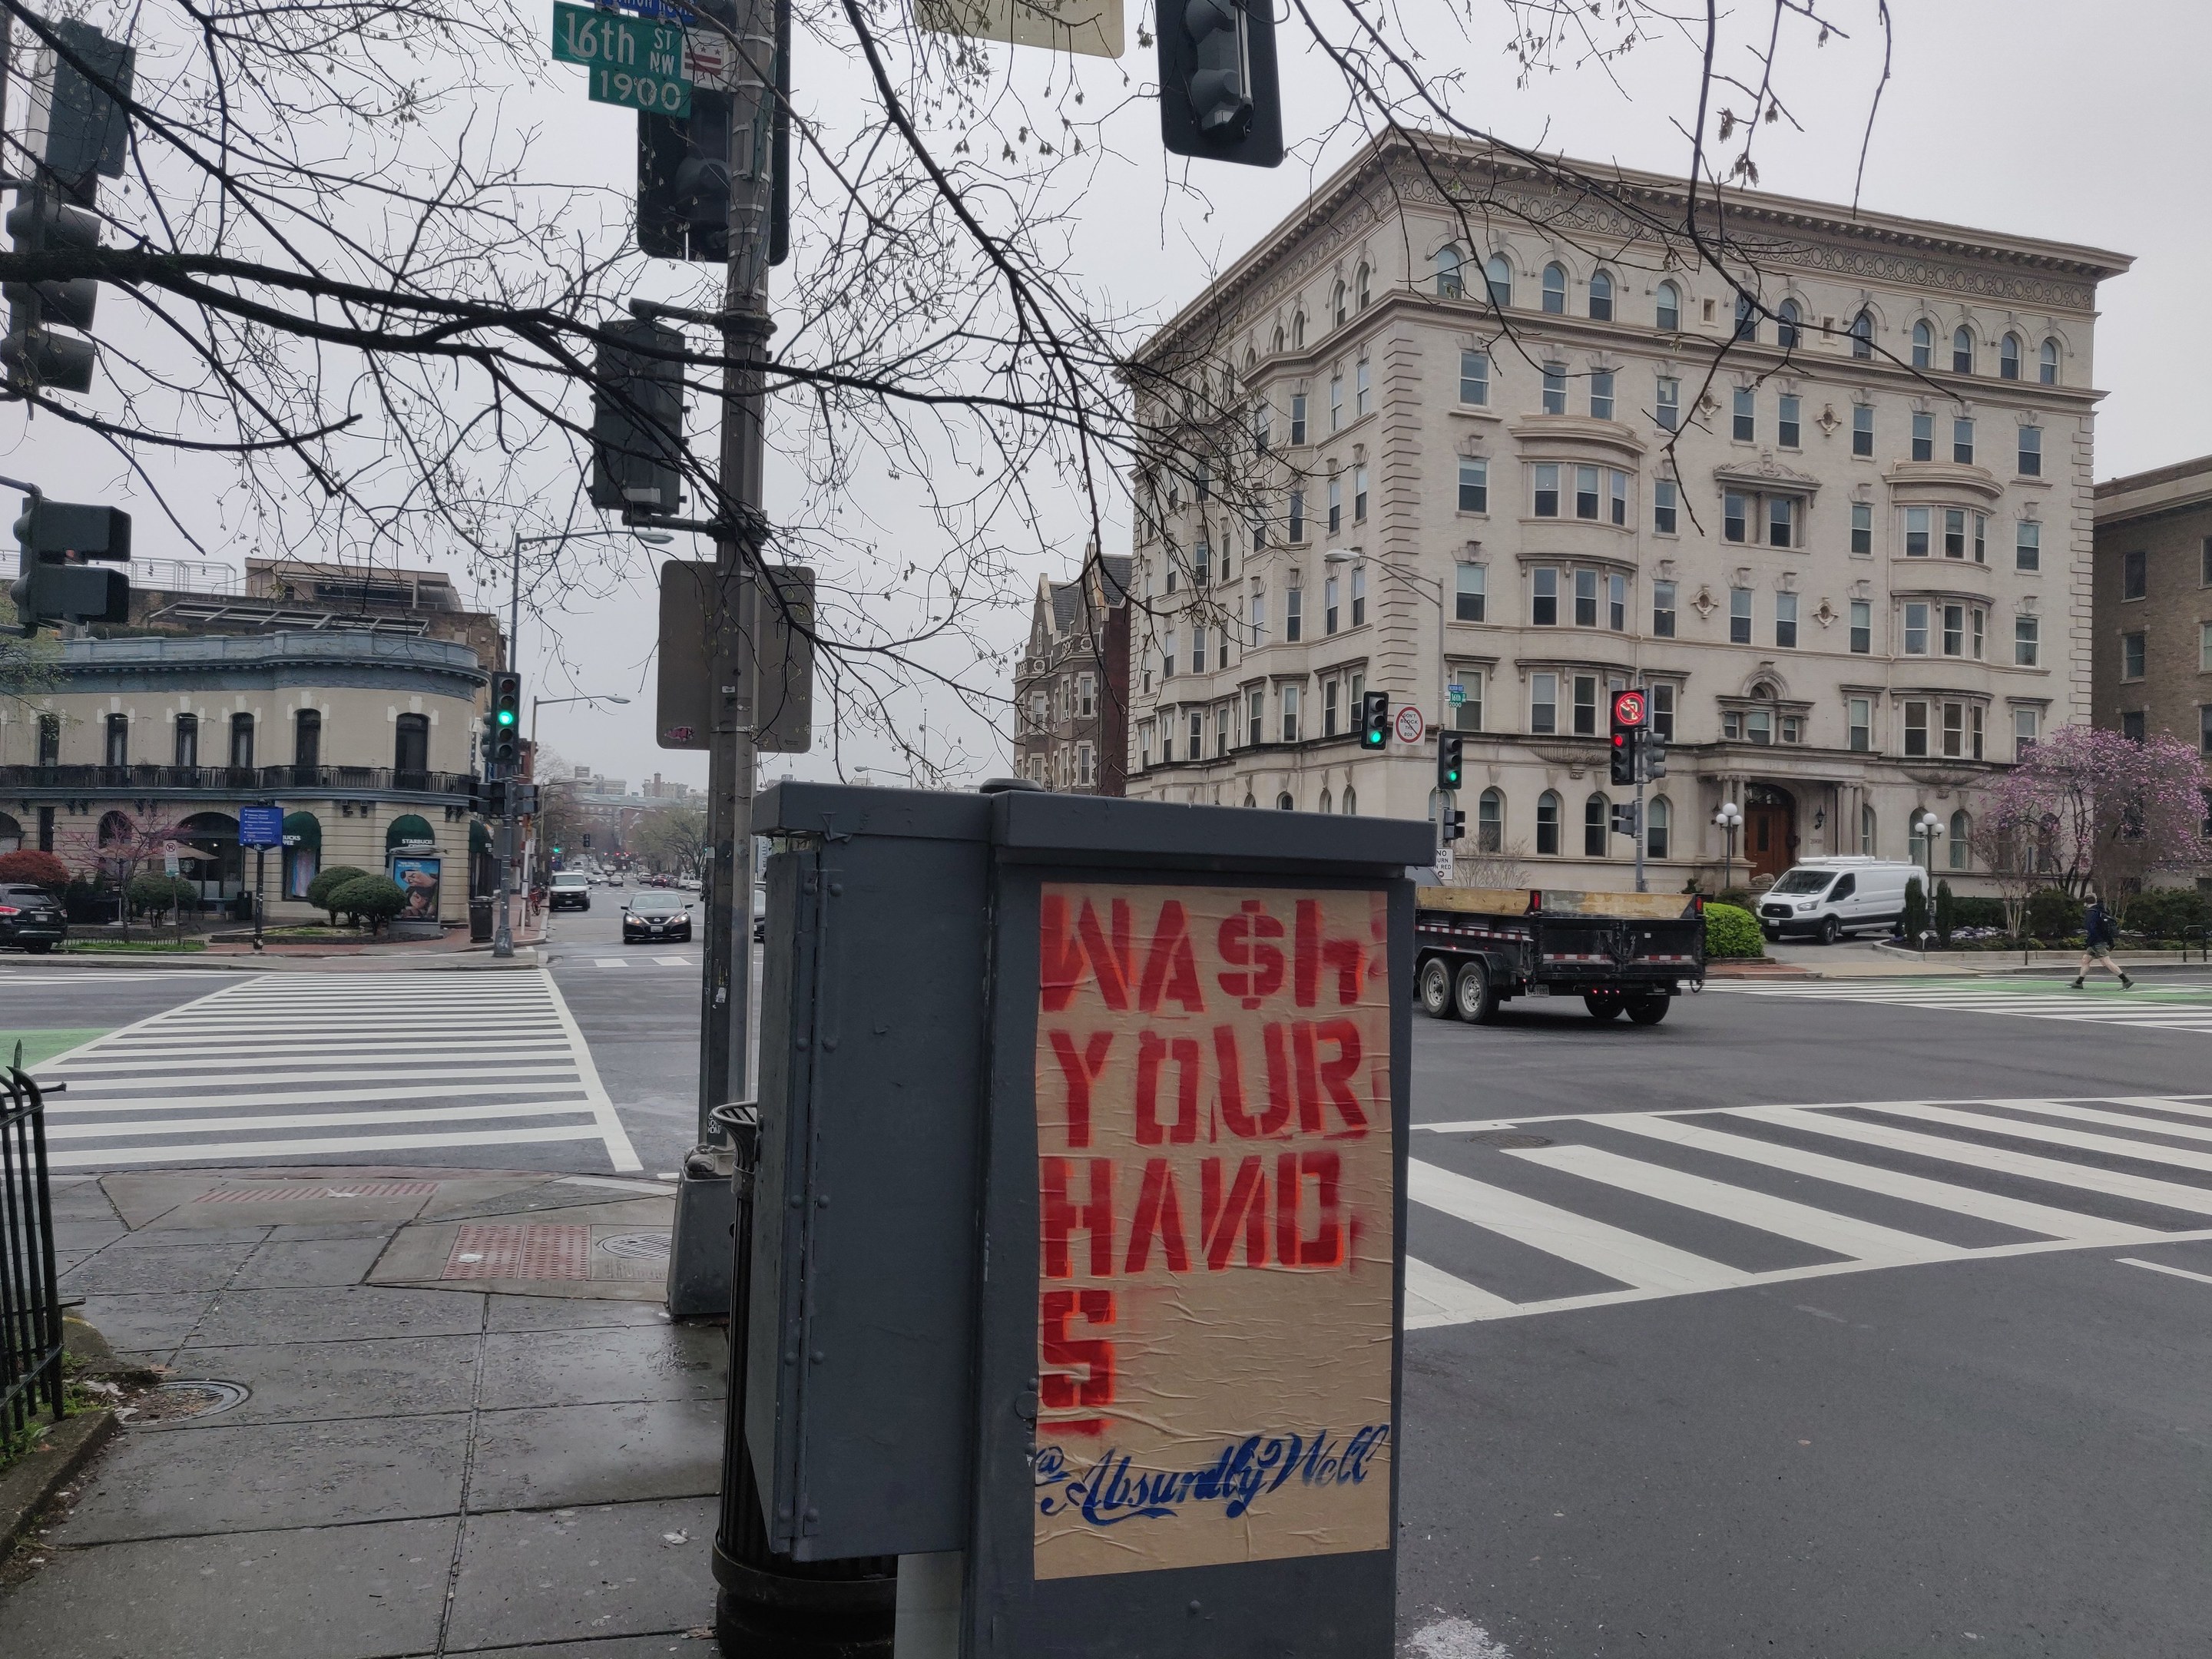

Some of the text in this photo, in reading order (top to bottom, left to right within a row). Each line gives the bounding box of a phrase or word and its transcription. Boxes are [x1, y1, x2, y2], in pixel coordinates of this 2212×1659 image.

[565, 12, 635, 65] 16th
[649, 51, 674, 75] NW
[654, 28, 673, 50] ST
[600, 70, 680, 111] 1900
[1051, 1018, 1367, 1147] YOUR
[1041, 1151, 1344, 1277] HAND
[1041, 1290, 1115, 1407] S
